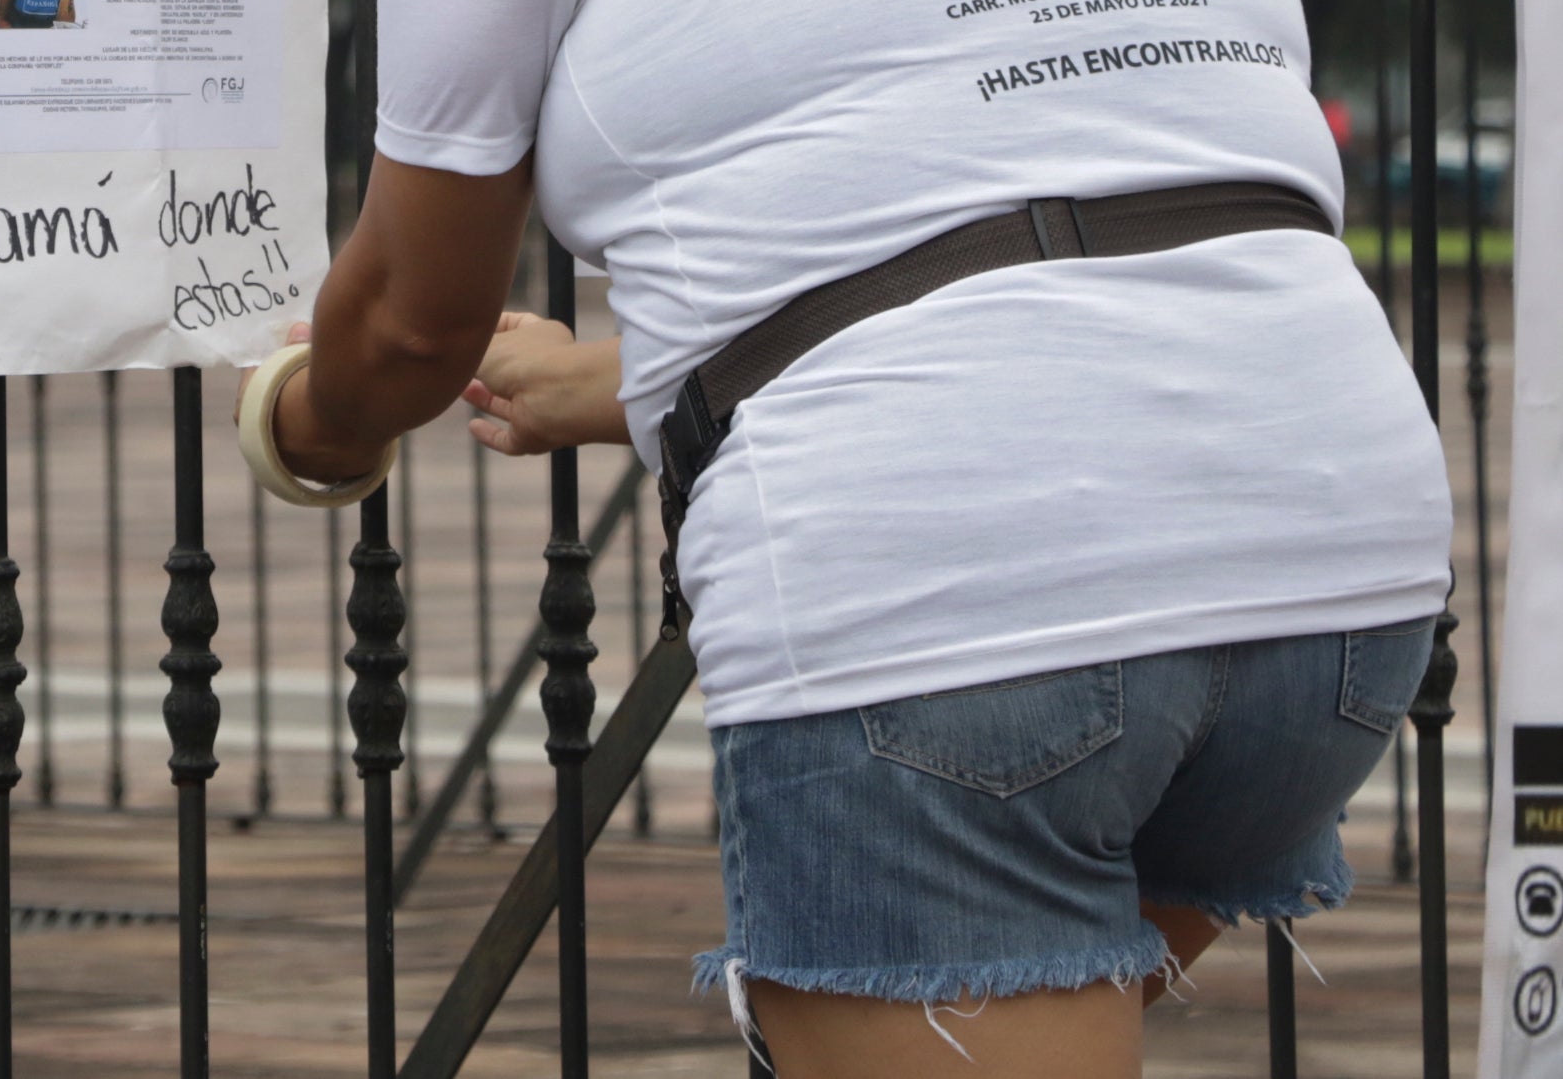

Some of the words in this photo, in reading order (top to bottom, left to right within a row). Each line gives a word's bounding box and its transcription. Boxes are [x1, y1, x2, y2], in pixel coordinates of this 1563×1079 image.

[1029, 9, 1053, 24] 25
[1056, 3, 1083, 19] DE
[221, 76, 245, 91] FGJ
[976, 54, 1081, 102] ¡HASTA
[1086, 39, 1287, 74] ENCONTRARLOS!
[159, 163, 280, 247] donde
